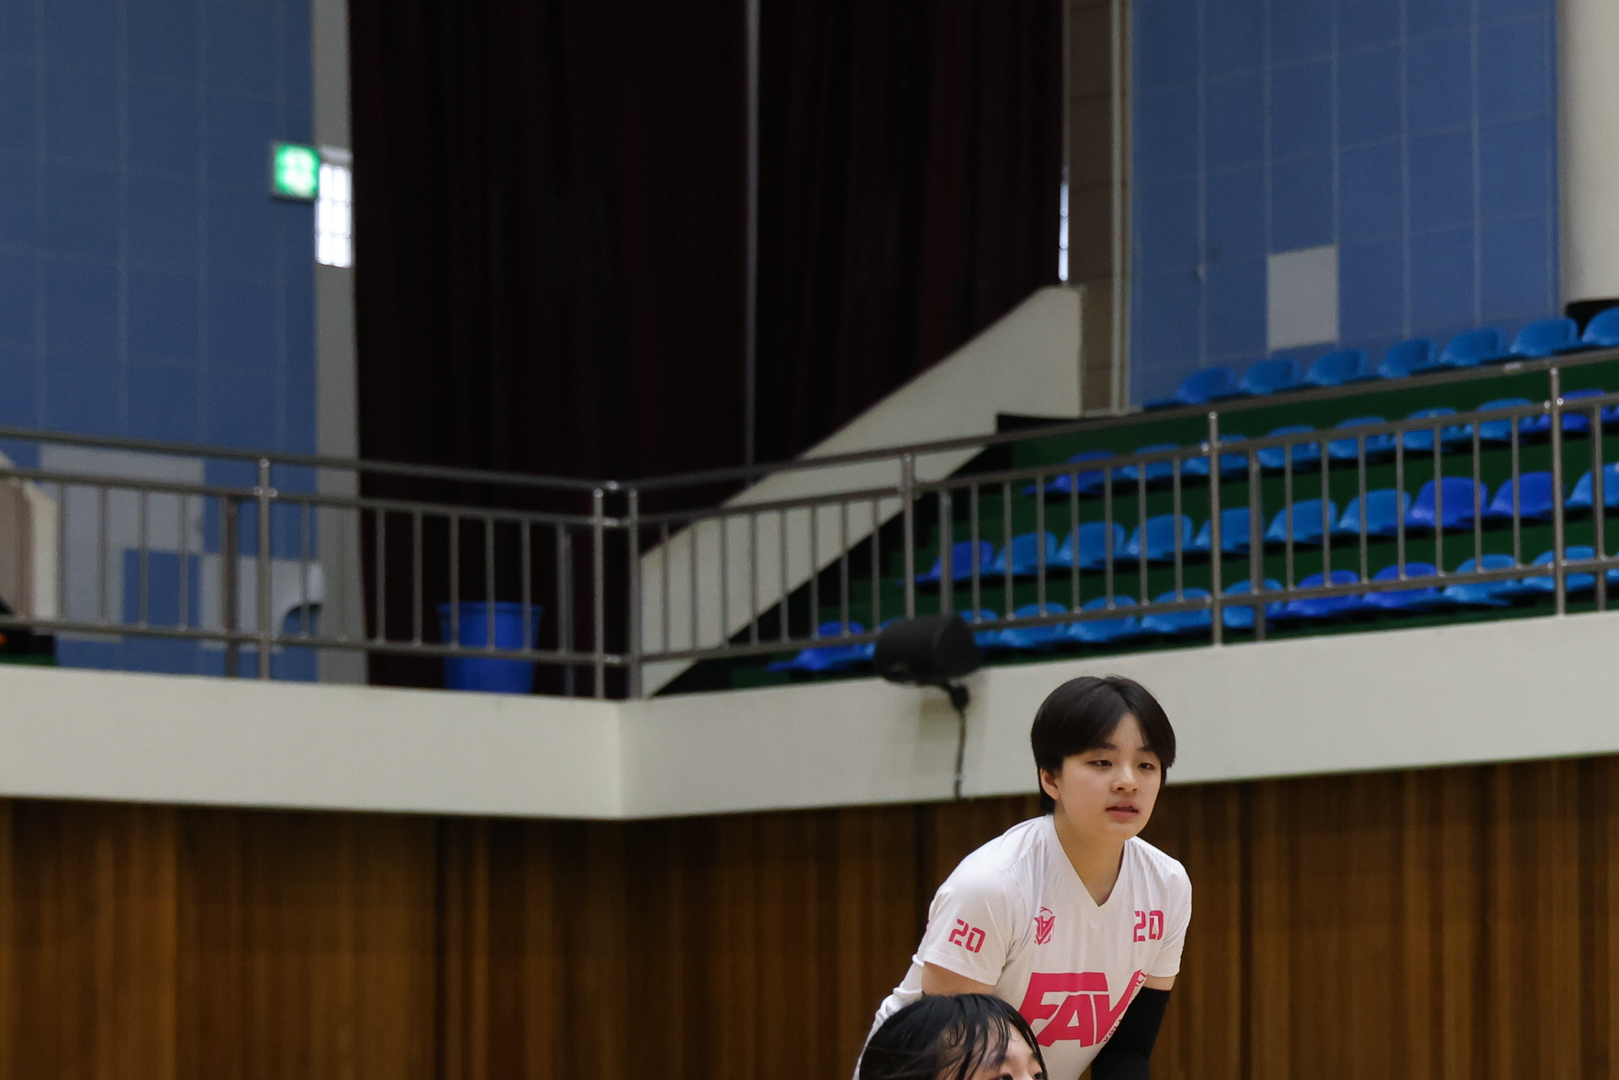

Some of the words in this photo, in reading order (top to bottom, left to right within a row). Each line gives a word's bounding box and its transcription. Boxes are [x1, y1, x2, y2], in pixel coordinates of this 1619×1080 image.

[948, 918, 987, 954] 20
[1133, 909, 1165, 943] 20
[1018, 969, 1142, 1048] FAV
